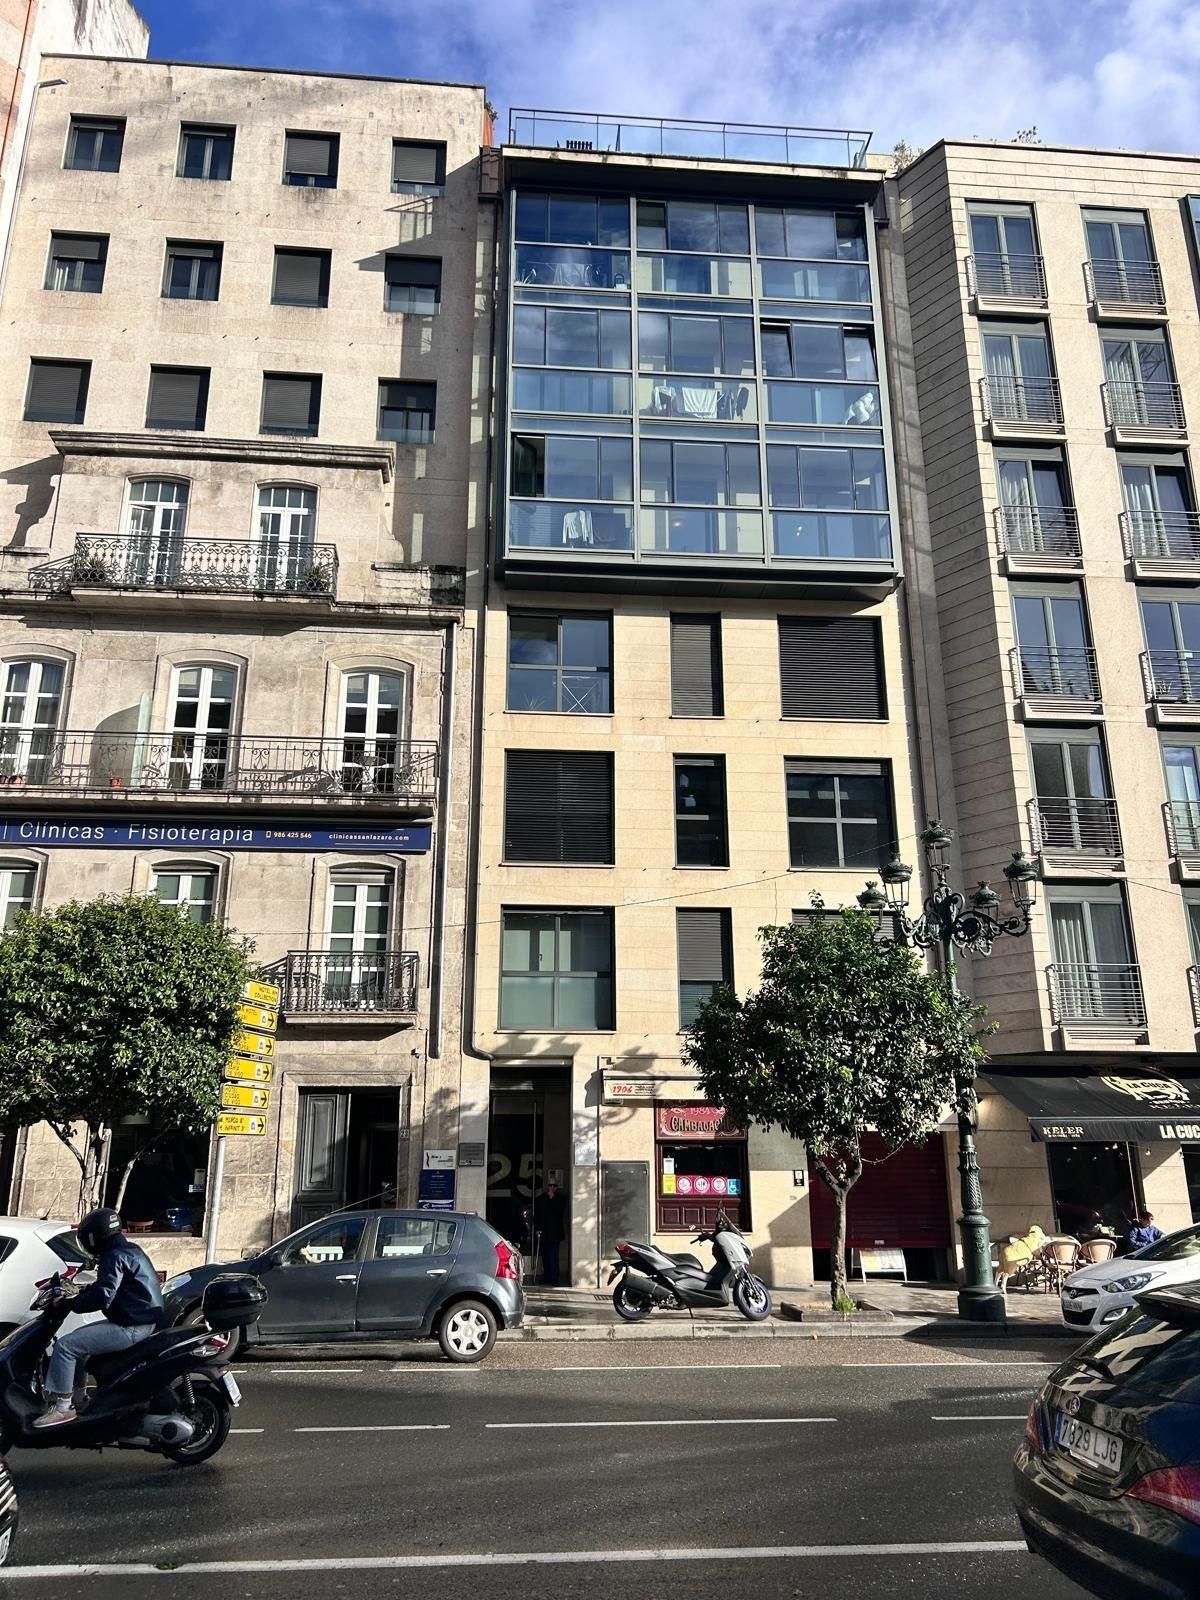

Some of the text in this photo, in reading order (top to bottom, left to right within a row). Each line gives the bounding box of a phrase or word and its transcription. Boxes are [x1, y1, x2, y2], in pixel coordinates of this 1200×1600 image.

[20, 821, 253, 845] Clínicas Fisioterapia
[273, 831, 286, 839] 986
[287, 831, 299, 839] 425
[612, 1085, 633, 1093] 1906
[1042, 1126, 1084, 1135] KELER
[1159, 1124, 1176, 1139] LA
[487, 1152, 543, 1198] 25
[1093, 1431, 1118, 1463] LJG
